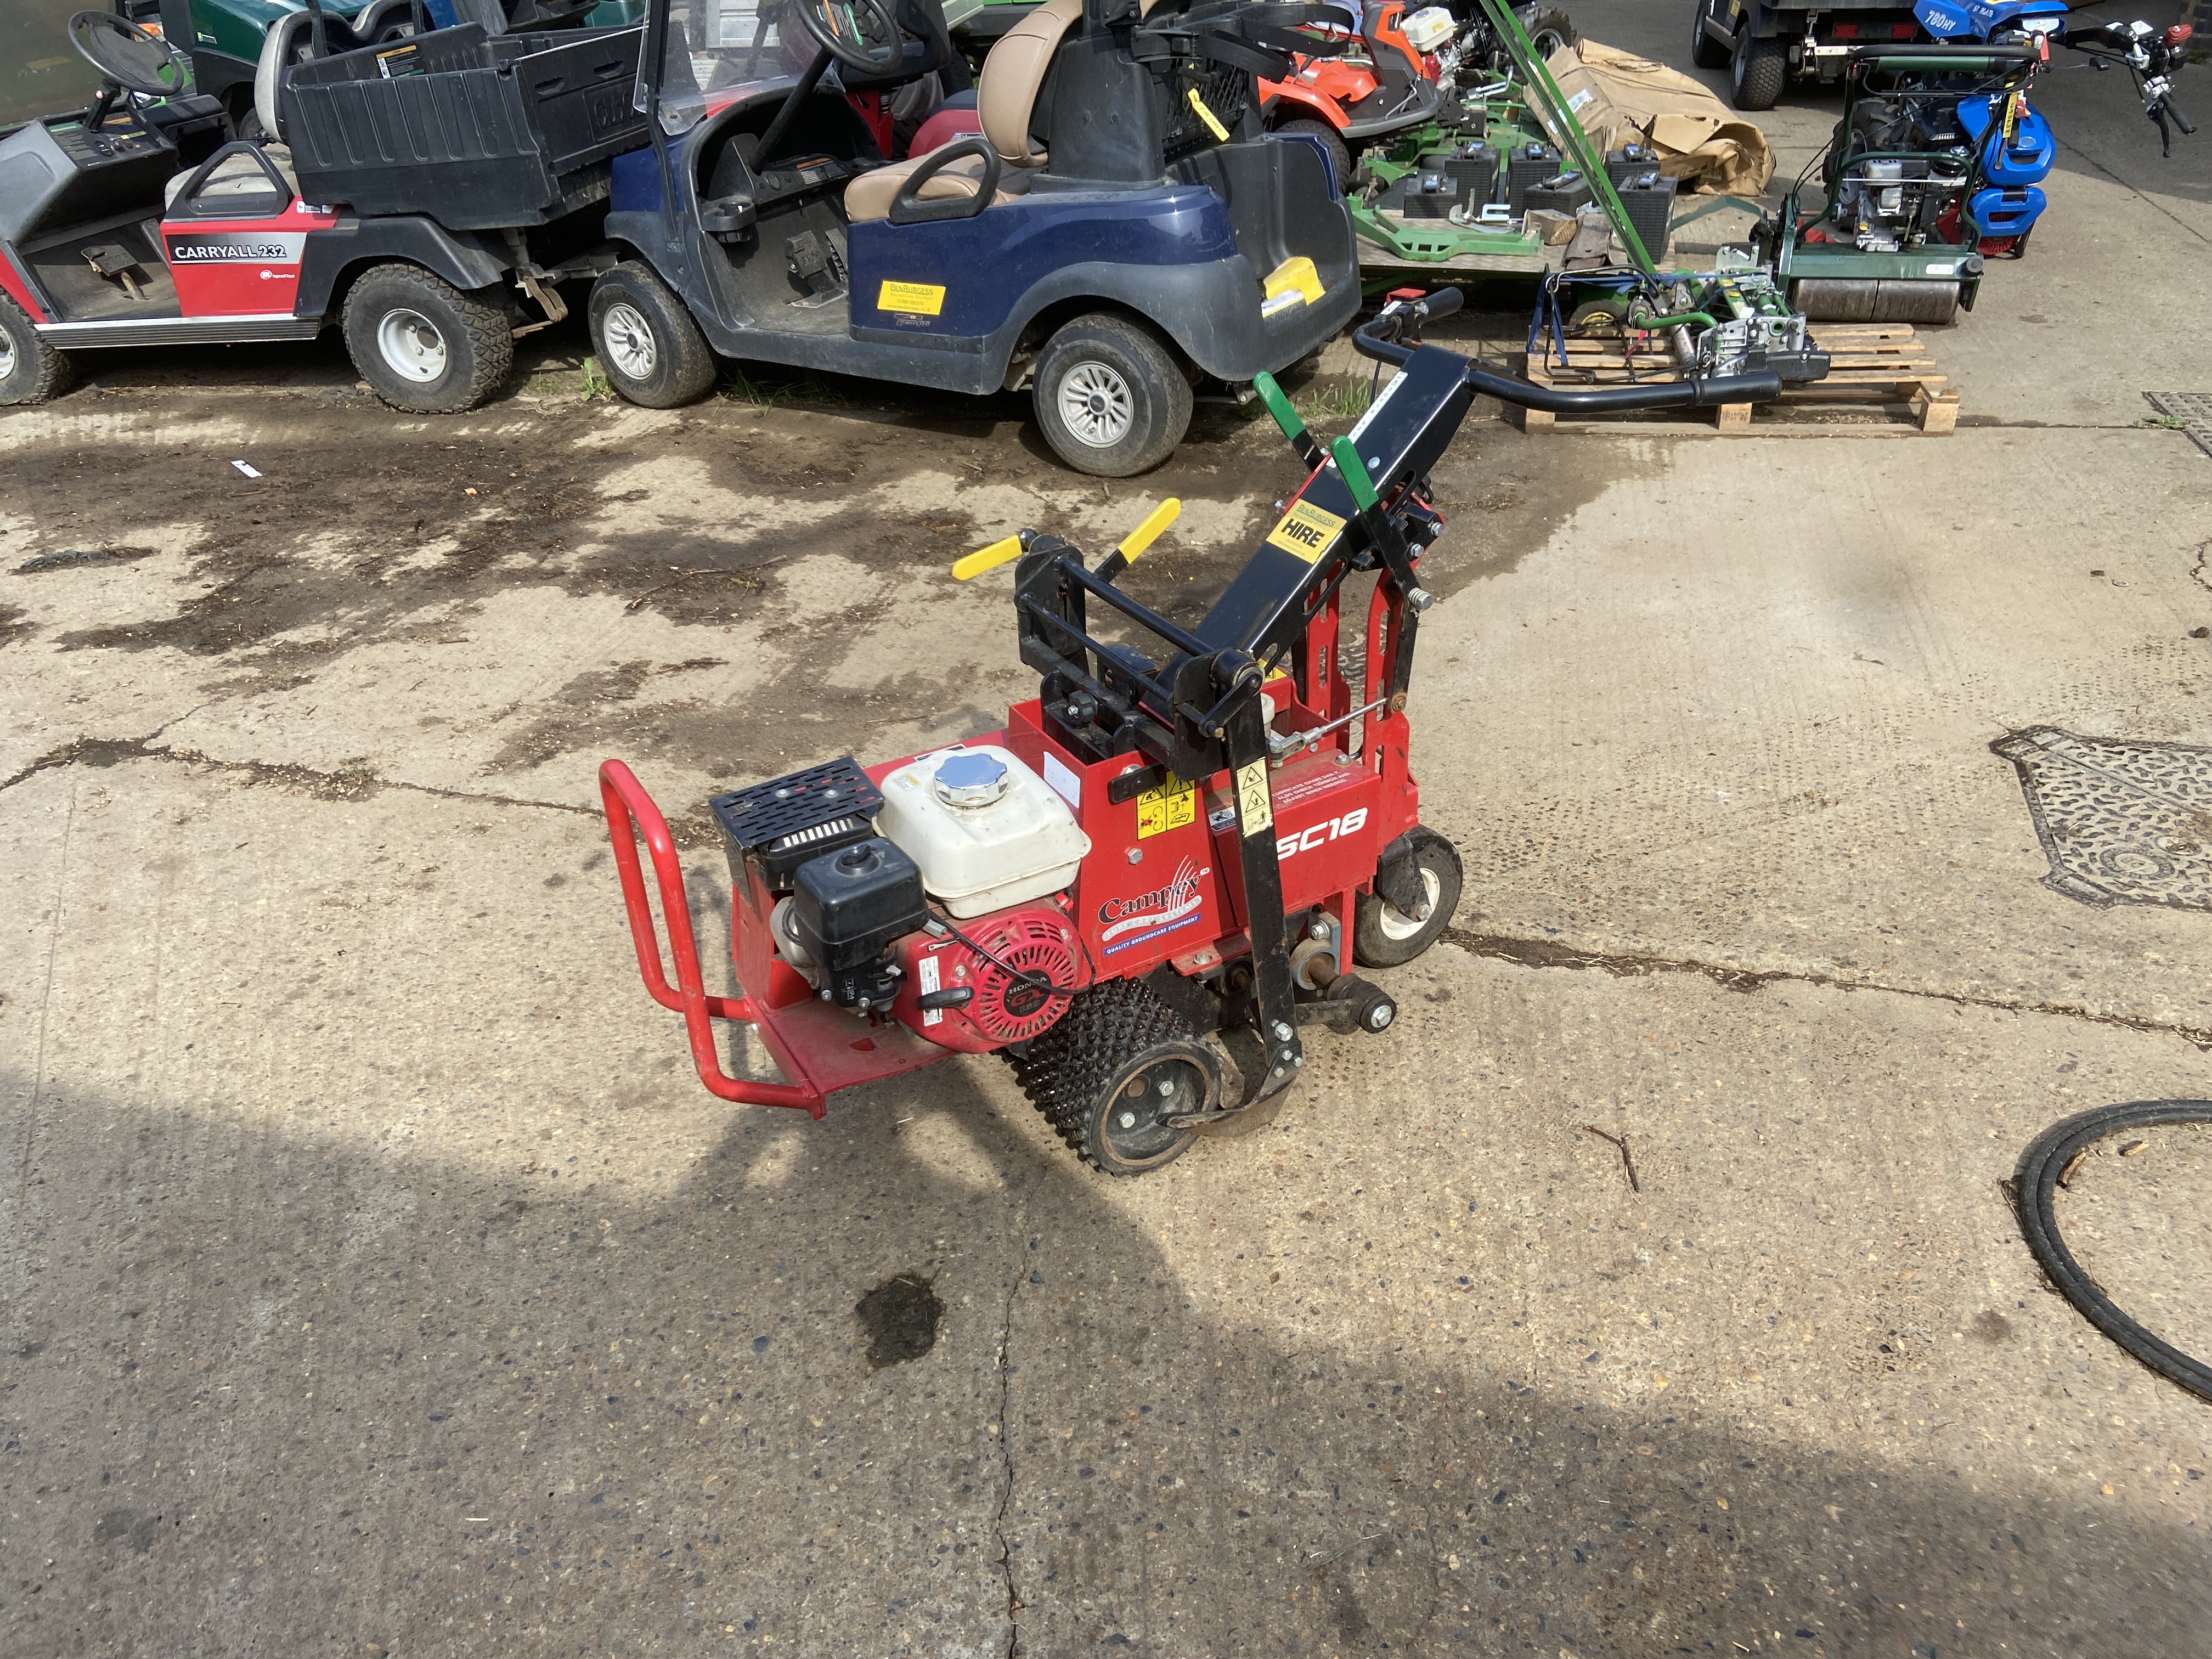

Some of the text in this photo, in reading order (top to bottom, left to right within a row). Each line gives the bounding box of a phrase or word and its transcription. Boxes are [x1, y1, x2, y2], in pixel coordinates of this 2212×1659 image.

[174, 244, 287, 259] CARRYALL 232
[1280, 518, 1325, 549] HIRE
[1271, 782, 1304, 797] LUBRICATE
[1304, 776, 1322, 786] CHAIN
[1278, 792, 1294, 800] ALSO
[1293, 785, 1314, 795] CHECK
[1313, 776, 1338, 787] TENSION
[1283, 794, 1305, 804] ADJUST
[1305, 787, 1323, 795] WHEN
[1276, 807, 1368, 861] SC18
[1098, 875, 1204, 924] Campey
[1107, 922, 1130, 937] TURF
[1159, 900, 1197, 922] SYSTEMS
[1107, 916, 1198, 955] QUALITY GROUNDCARE EQUIPMENT
[1008, 977, 1047, 995] HONA
[1019, 1000, 1041, 1013] 160
